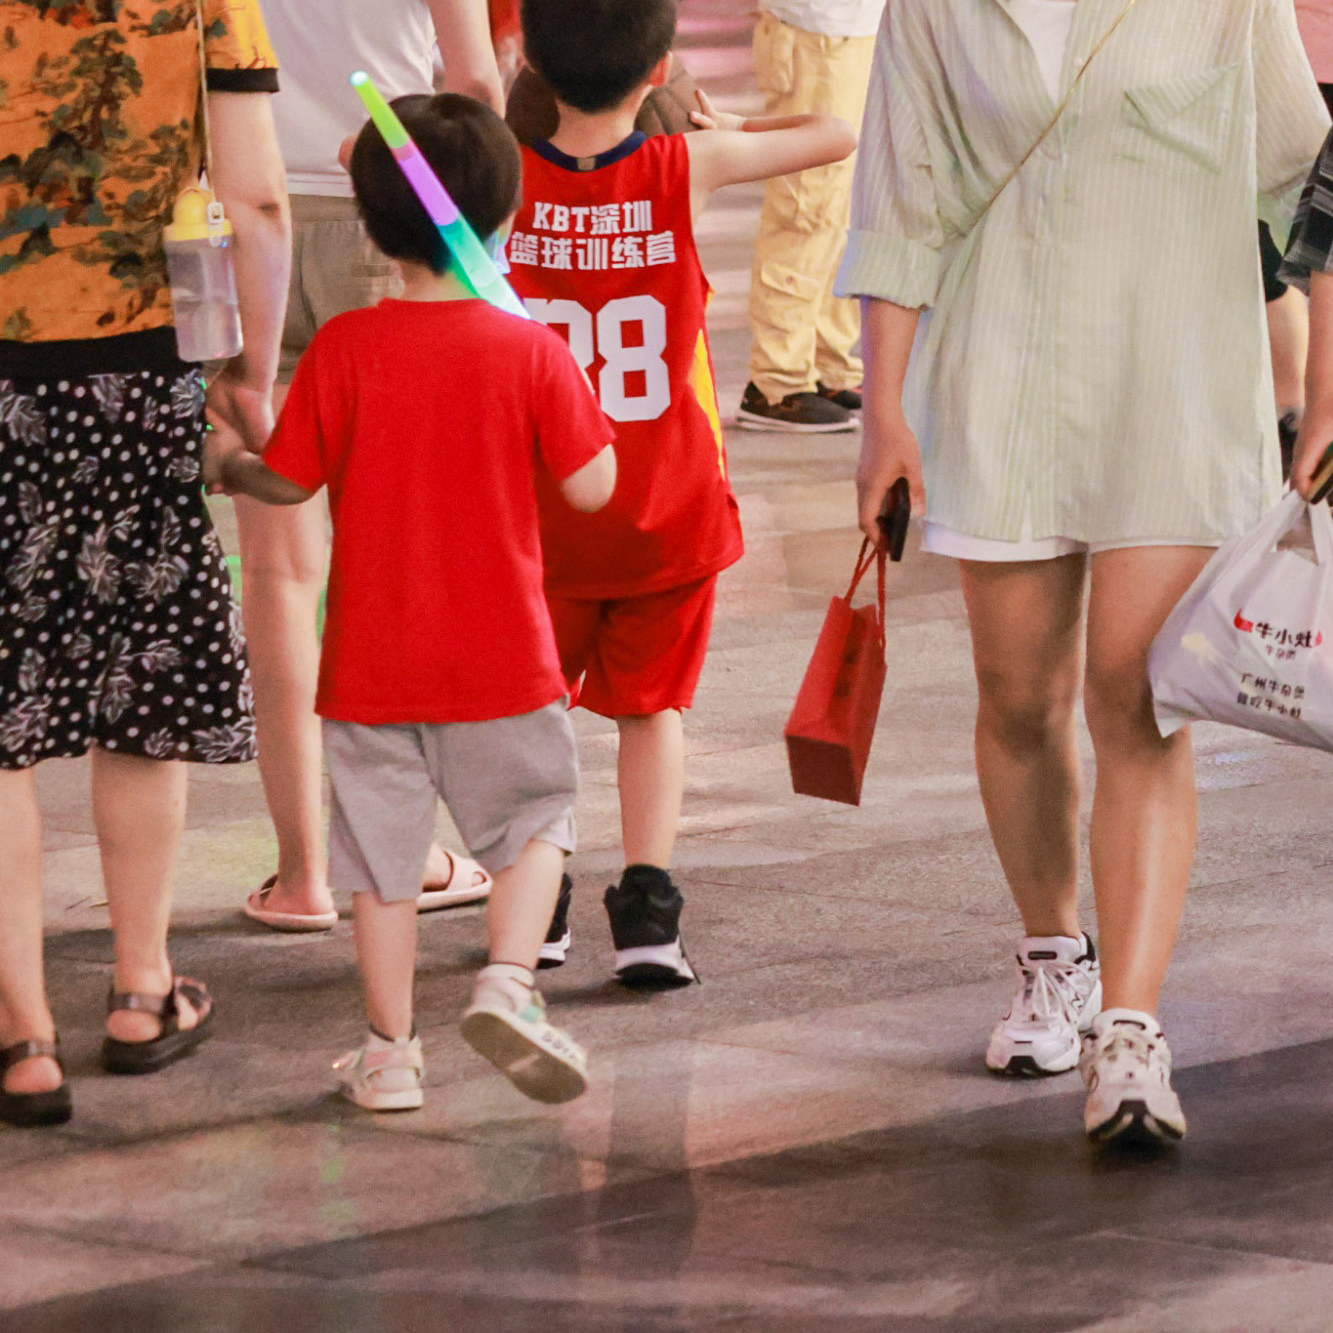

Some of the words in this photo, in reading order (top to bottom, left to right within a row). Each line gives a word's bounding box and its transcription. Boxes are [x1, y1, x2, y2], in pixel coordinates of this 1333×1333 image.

[532, 200, 654, 235] KBT深圳
[509, 230, 676, 271] 篮球训练营
